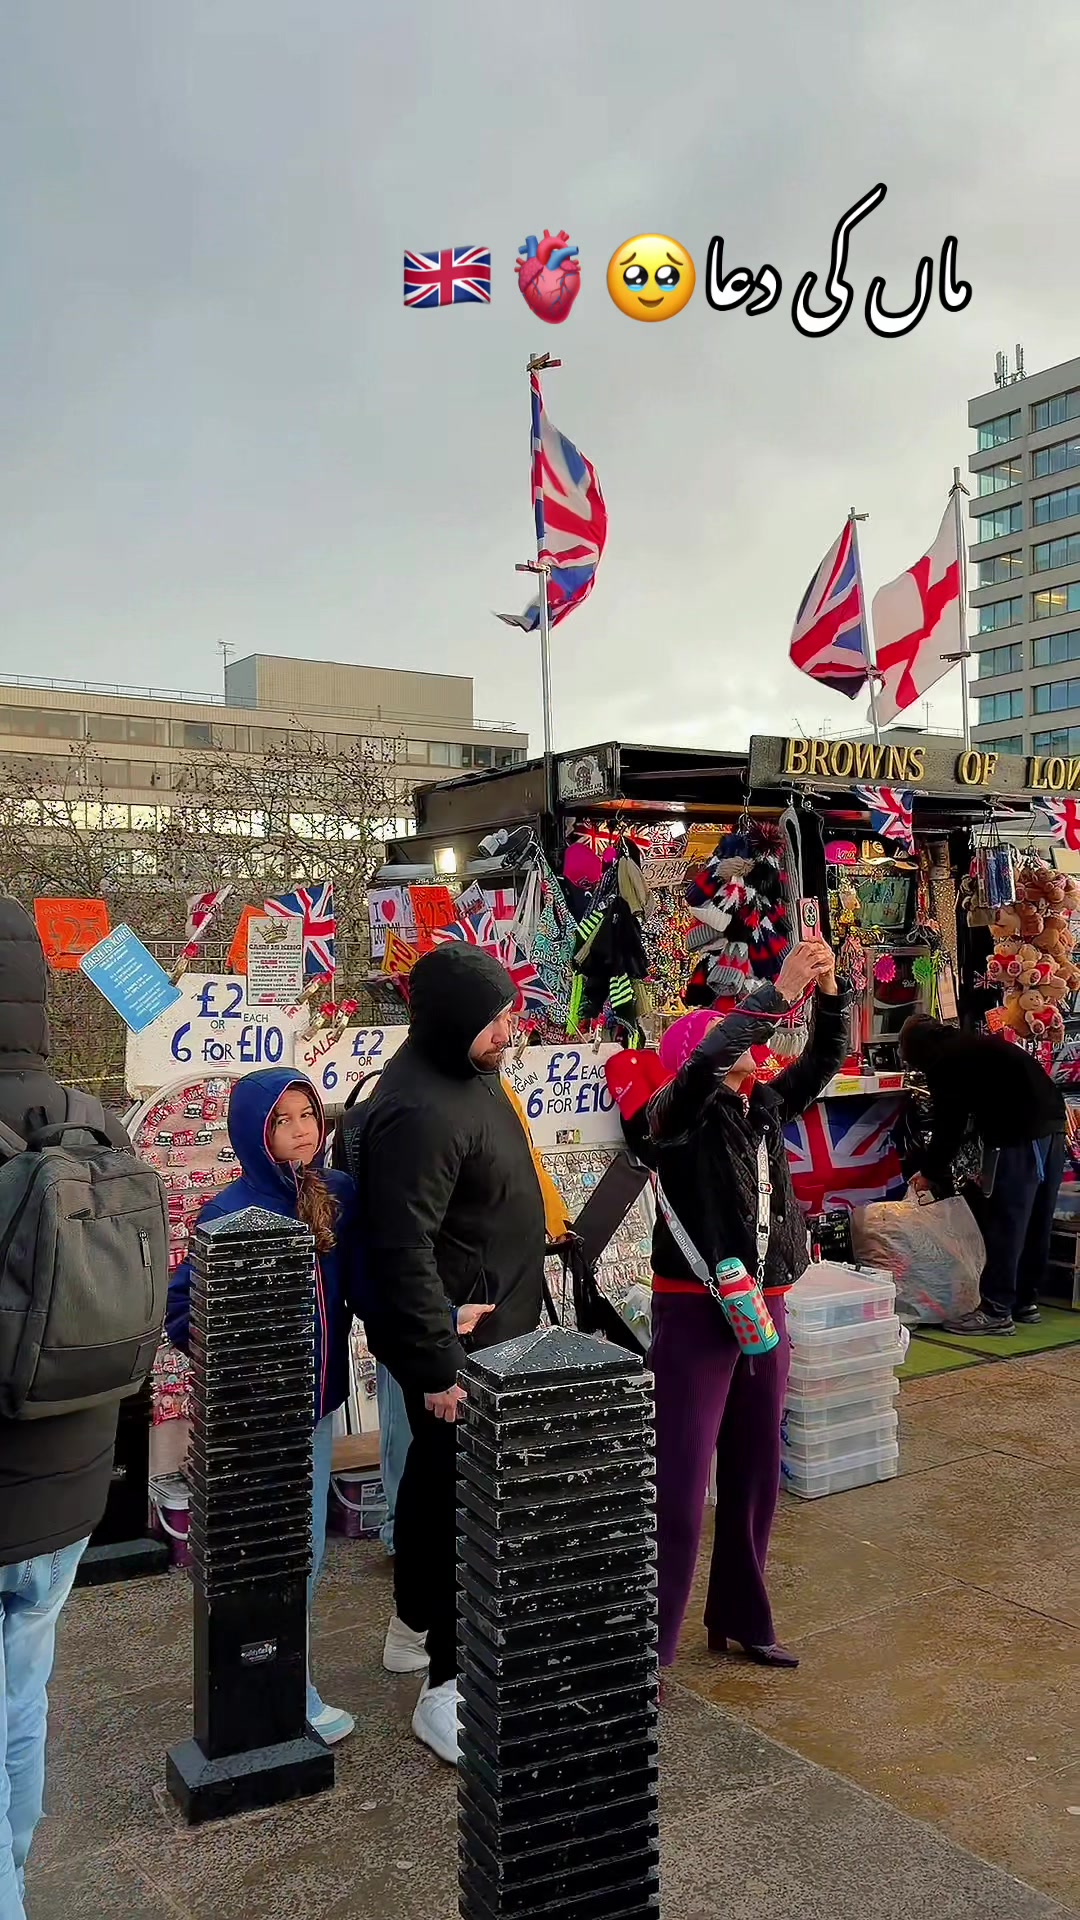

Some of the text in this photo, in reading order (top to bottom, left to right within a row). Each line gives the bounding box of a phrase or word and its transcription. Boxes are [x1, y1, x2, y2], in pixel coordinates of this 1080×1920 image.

[784, 737, 926, 781] BROWNS
[961, 750, 999, 785] OF
[373, 901, 381, 922] I
[82, 947, 105, 970] CASH
[112, 928, 130, 945] KING
[197, 981, 269, 1023] £2 EACH
[210, 1019, 226, 1029] OR
[171, 1022, 283, 1062] 6 FOR £10
[303, 1031, 338, 1067] SALE
[351, 1029, 384, 1057] £2
[322, 1061, 338, 1090] 6
[358, 1056, 373, 1067] OR
[503, 1057, 524, 1078] RAB
[546, 1051, 607, 1083] £2 EAC
[512, 1071, 539, 1094] RGAIN
[514, 1074, 523, 1084] A
[552, 1081, 571, 1096] OR
[526, 1088, 545, 1119] 6
[546, 1098, 572, 1114] FOR
[575, 1083, 615, 1114] £10
